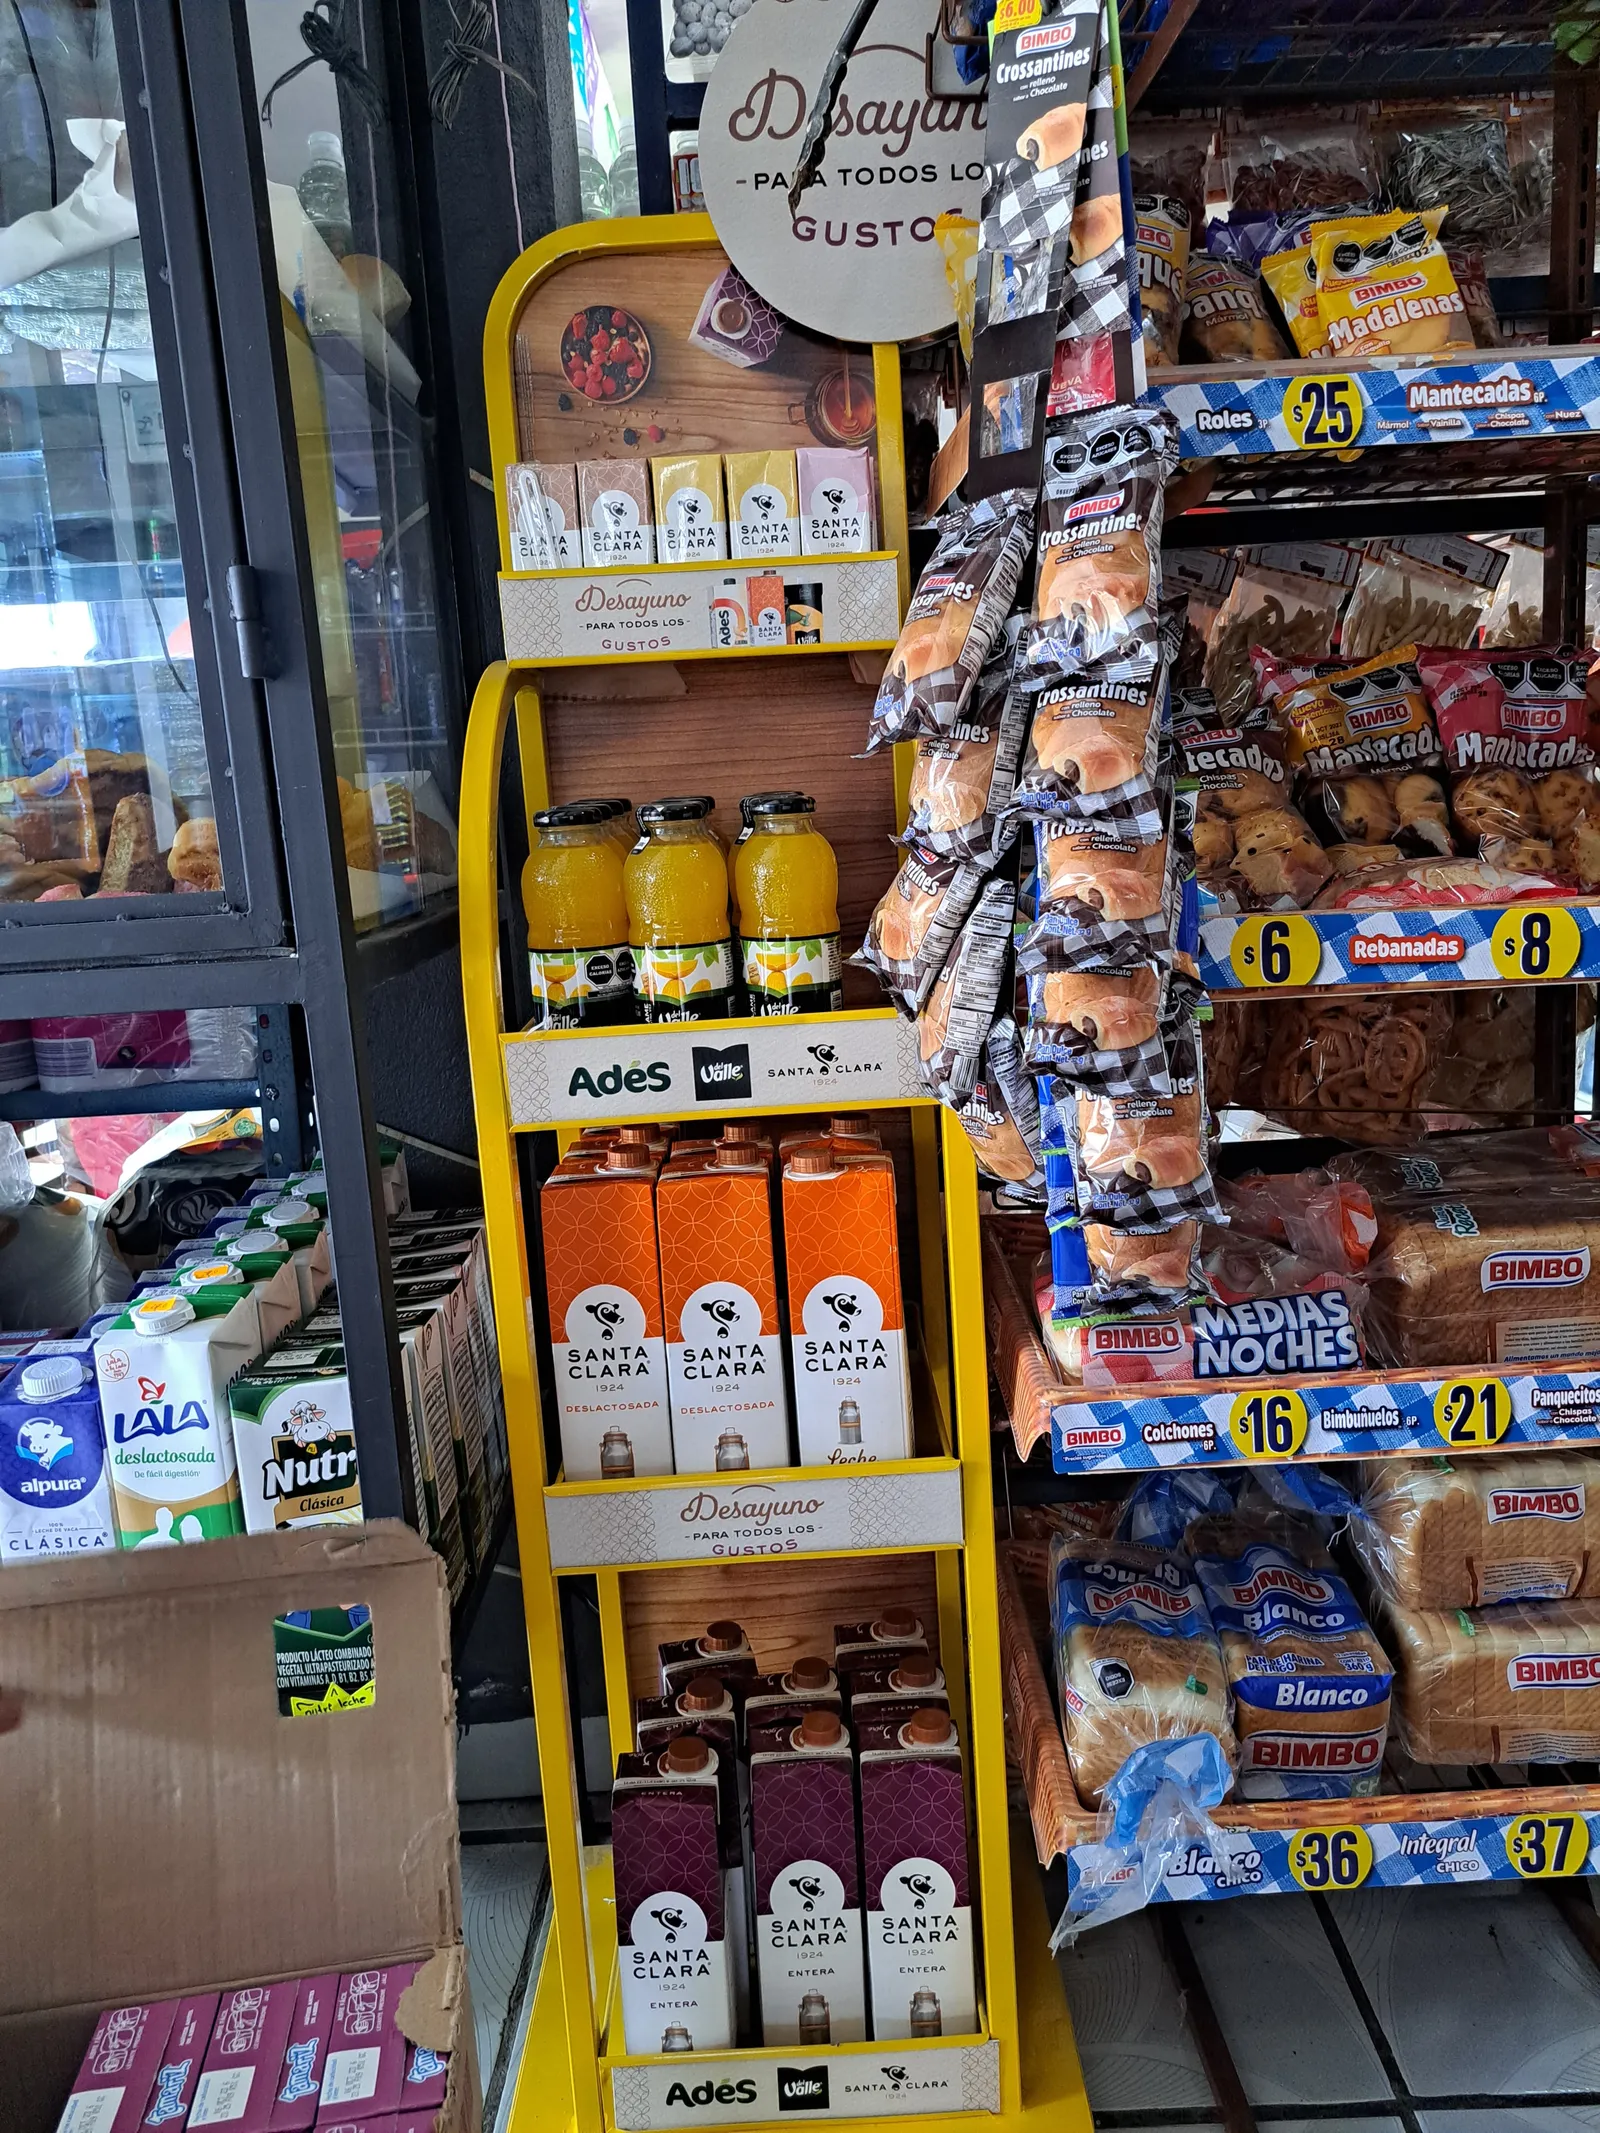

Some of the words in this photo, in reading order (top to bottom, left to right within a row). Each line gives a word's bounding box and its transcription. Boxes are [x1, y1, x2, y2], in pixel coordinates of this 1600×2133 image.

[1020, 26, 1072, 50] BIMBO
[996, 47, 1091, 84] Crossantines
[1029, 76, 1056, 88] relleno
[1030, 82, 1068, 97] Chocolate
[728, 68, 988, 158] Dsayun
[754, 171, 827, 190] PAA
[838, 164, 938, 186] TODOS
[951, 162, 985, 181] LO
[791, 207, 963, 248] GUSTO
[1354, 276, 1424, 301] BIMBO
[1328, 291, 1464, 350] Madalenas
[1409, 377, 1531, 408] Mantecadas
[1199, 409, 1252, 430] Roles
[1292, 381, 1353, 445] $25
[1494, 411, 1524, 421] Chispas
[1555, 409, 1581, 420] Nuez
[1377, 420, 1409, 430] Mármol
[1431, 418, 1462, 429] Vainilla
[1490, 418, 1529, 429] Chocolate
[1068, 496, 1121, 519] BIMBO
[741, 523, 789, 535] SANTA
[812, 518, 860, 529] SANTA
[593, 530, 641, 541] SANTA
[741, 533, 790, 546] CLARA
[812, 528, 860, 540] CLARA
[593, 540, 642, 552] CLARA
[827, 541, 845, 549] 1924
[1073, 539, 1100, 550] relleno
[1073, 543, 1114, 558] Chocolate
[575, 584, 691, 617] Desayuno
[586, 621, 615, 630] PARA
[618, 619, 658, 629] TODOS
[662, 618, 684, 627] LOS
[758, 625, 783, 633] SANTA
[602, 635, 671, 651] GUSTOS
[758, 631, 783, 639] CLARA
[1071, 701, 1101, 709] relleno
[1072, 708, 1115, 718] Chocolate
[1347, 704, 1408, 729] BIMBO
[1504, 709, 1562, 727] BIMBO
[1304, 723, 1443, 776] Mantecad
[1036, 791, 1057, 800] Dulce
[1092, 843, 1137, 853] Chocolate
[1243, 920, 1291, 984] $6
[1354, 938, 1459, 960] Rebanadas
[1504, 912, 1551, 976] $8
[1052, 1045, 1072, 1055] Dulce
[700, 1063, 742, 1085] Valle
[768, 1067, 814, 1078] SANTA
[835, 1063, 882, 1074] CLARA
[812, 1078, 838, 1087] 1924
[1127, 1099, 1157, 1109] relleno
[1130, 1107, 1173, 1118] Chocolate
[1489, 1256, 1583, 1281] BIMBO
[409, 1279, 448, 1290] Nutri
[1195, 1292, 1352, 1337] MEDIAS
[1095, 1325, 1179, 1350] BIMBO
[568, 1345, 648, 1363] SANTA
[683, 1344, 764, 1363] SANTA
[805, 1338, 885, 1355] SANTA
[1198, 1325, 1358, 1375] NOCHES
[568, 1362, 650, 1380] CLARA
[684, 1361, 765, 1380] CLARA
[805, 1355, 887, 1372] CLARA
[595, 1383, 624, 1392] 1924
[711, 1383, 740, 1392] 1924
[832, 1377, 860, 1385] 1924
[566, 1401, 660, 1414] DESLACTOSADA
[680, 1401, 775, 1415] DESLACTOSADA
[1443, 1384, 1496, 1441] $21
[1559, 1408, 1592, 1416] Chispas
[114, 1401, 209, 1443] LALA
[1239, 1395, 1291, 1453] $16
[1322, 1407, 1399, 1430] Bimbuñuelos
[1553, 1415, 1597, 1425] Chocolate
[1066, 1429, 1121, 1447] BIMBO
[1143, 1422, 1214, 1442] Colchones
[115, 1446, 216, 1465] deslactosada
[828, 1448, 877, 1464] Leche
[134, 1470, 145, 1478] De
[146, 1469, 163, 1478] fácil
[264, 1449, 357, 1500] Nutr
[21, 1478, 82, 1495] alpura
[300, 1495, 344, 1512] Clásica
[680, 1492, 824, 1526] Desayuno
[1494, 1491, 1580, 1515] BIMBO
[693, 1530, 729, 1540] PARA
[734, 1527, 783, 1538] TODOS
[787, 1524, 814, 1534] LOS
[9, 1535, 105, 1551] CLÁSICA
[711, 1538, 798, 1558] GUSTOS
[1243, 1600, 1346, 1631] Blanco
[277, 1651, 309, 1664] PRODUCTO
[310, 1648, 333, 1661] LÁCTEO
[334, 1646, 372, 1660] COMBINADO
[277, 1663, 304, 1676] VEGETAL
[304, 1659, 370, 1675] ULTRAPASTEURIZADO
[1263, 1662, 1296, 1673] TRIGO
[1344, 1662, 1363, 1671] 360
[1366, 1663, 1374, 1673] g
[277, 1677, 290, 1688] CON
[290, 1675, 324, 1687] VITAMINAS
[338, 1696, 367, 1707] leche
[1275, 1681, 1368, 1706] Blanco
[1252, 1738, 1379, 1767] BIMBO
[1400, 1829, 1478, 1860] Integral
[1512, 1817, 1574, 1874] $37
[1296, 1831, 1361, 1887] $36
[1436, 1859, 1479, 1873] CHICO
[771, 1916, 846, 1933] SANTA
[882, 1914, 957, 1930] SANTA
[771, 1932, 847, 1948] CLARA
[882, 1929, 958, 1945] CLARA
[633, 1948, 709, 1964] SANTA
[796, 1951, 823, 1959] 1924
[907, 1948, 934, 1956] 1924
[633, 1964, 710, 1979] CLARA
[788, 1968, 835, 1977] ENTERA
[899, 1965, 946, 1974] ENTERA
[659, 1983, 686, 1991] 1924
[650, 2000, 698, 2009] ENTERA
[784, 2081, 822, 2097] Valle
[844, 2083, 886, 2092] SANTA
[906, 2080, 948, 2090] CLARA
